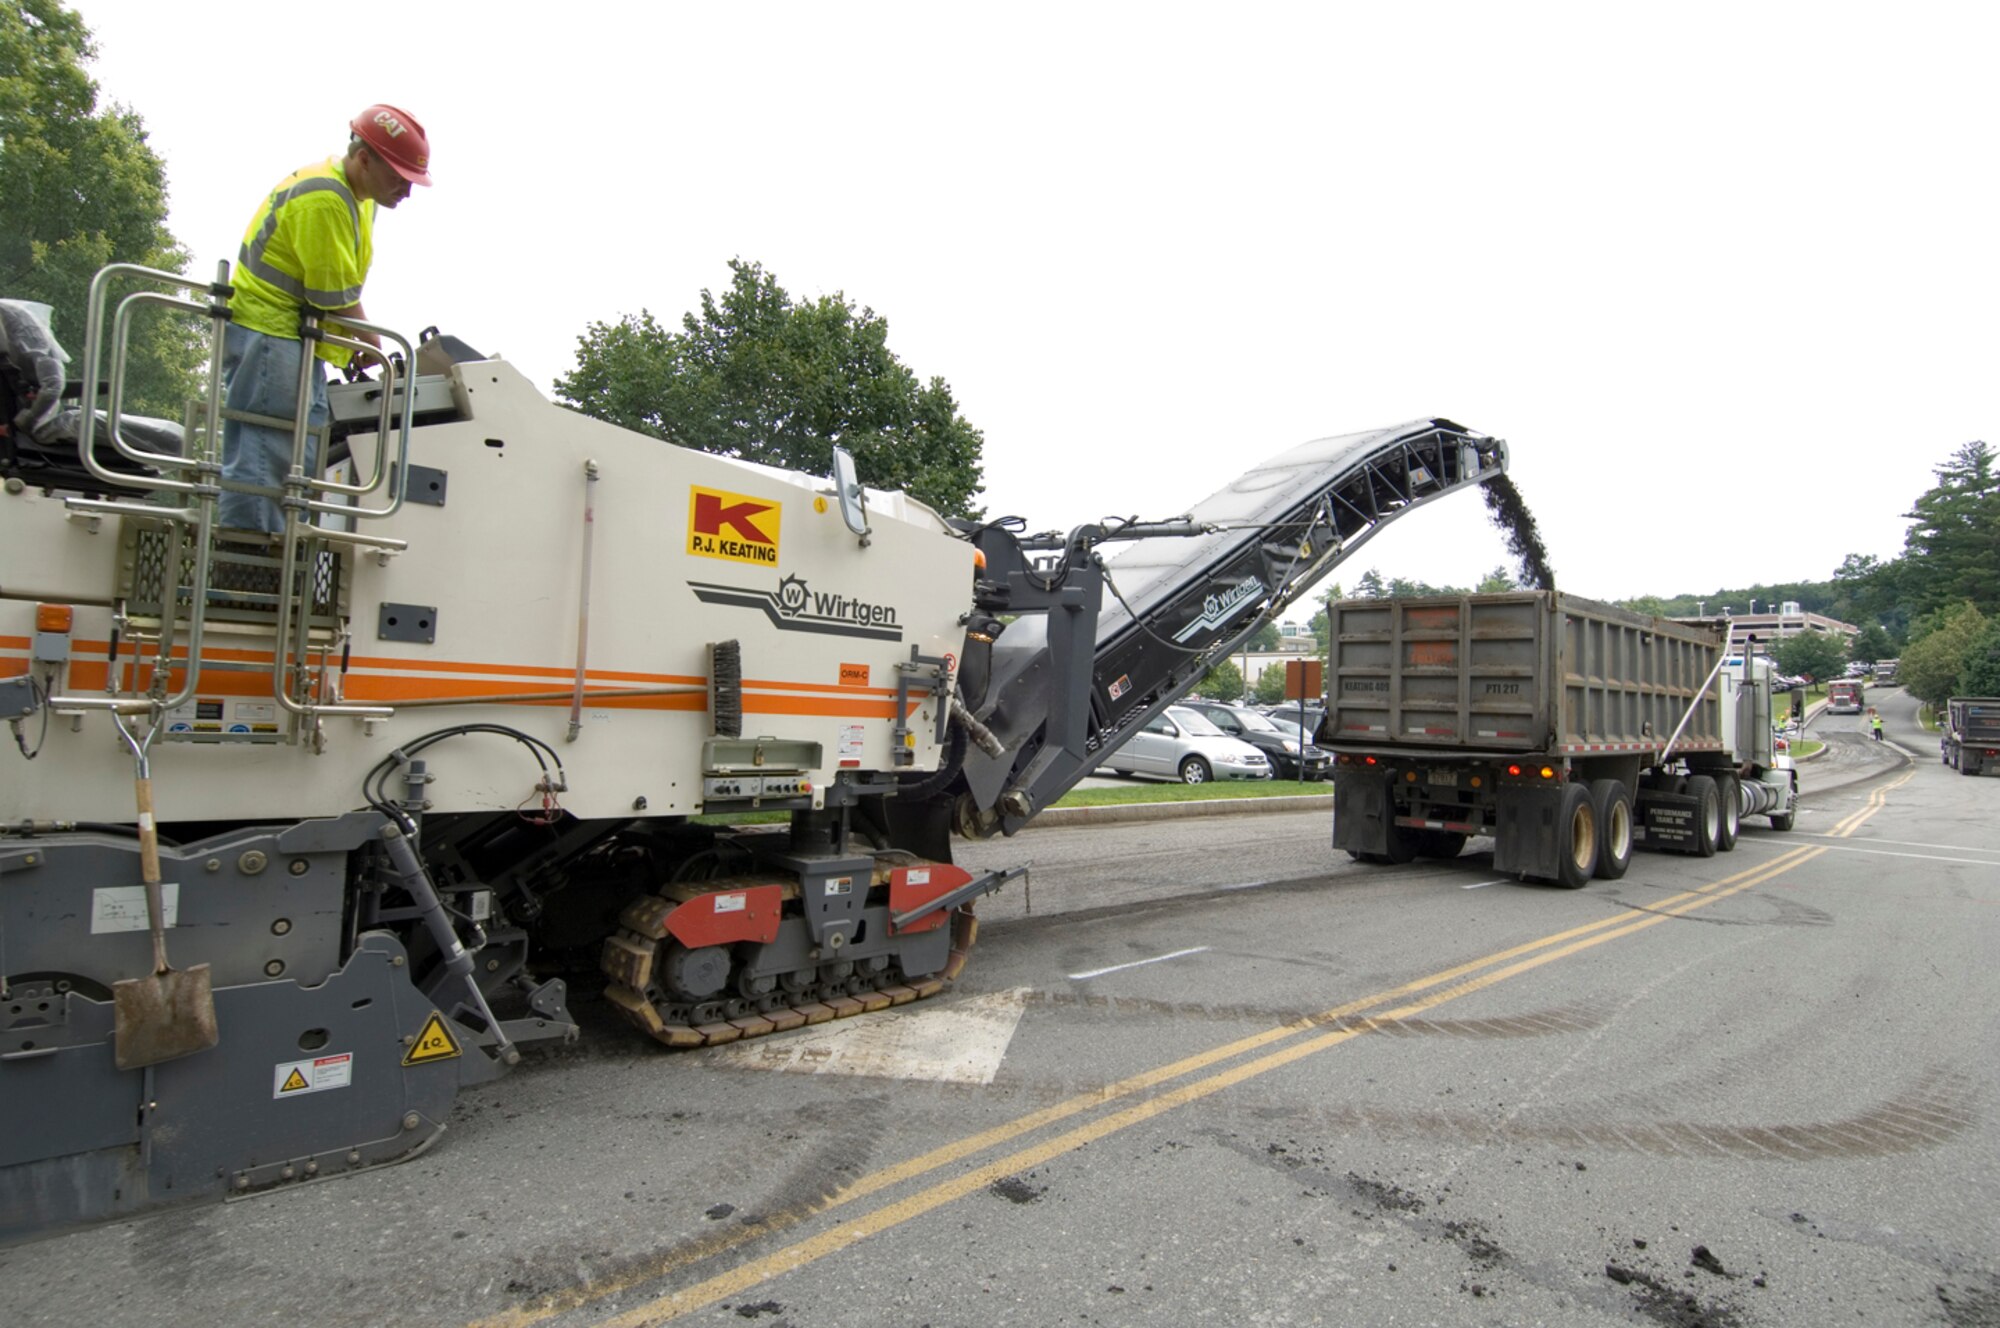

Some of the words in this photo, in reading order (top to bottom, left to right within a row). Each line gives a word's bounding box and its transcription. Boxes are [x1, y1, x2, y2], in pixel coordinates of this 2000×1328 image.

[374, 111, 407, 137] CAT
[694, 493, 775, 544] K
[693, 536, 715, 553] P.J.
[720, 540, 776, 562] KEATING
[1218, 575, 1257, 608] Wirtgen
[814, 592, 896, 626] Wirtgen
[841, 669, 868, 680] ORM-C
[1345, 682, 1374, 692] KEATING
[1485, 683, 1501, 693] PTI
[1503, 683, 1519, 694] 217
